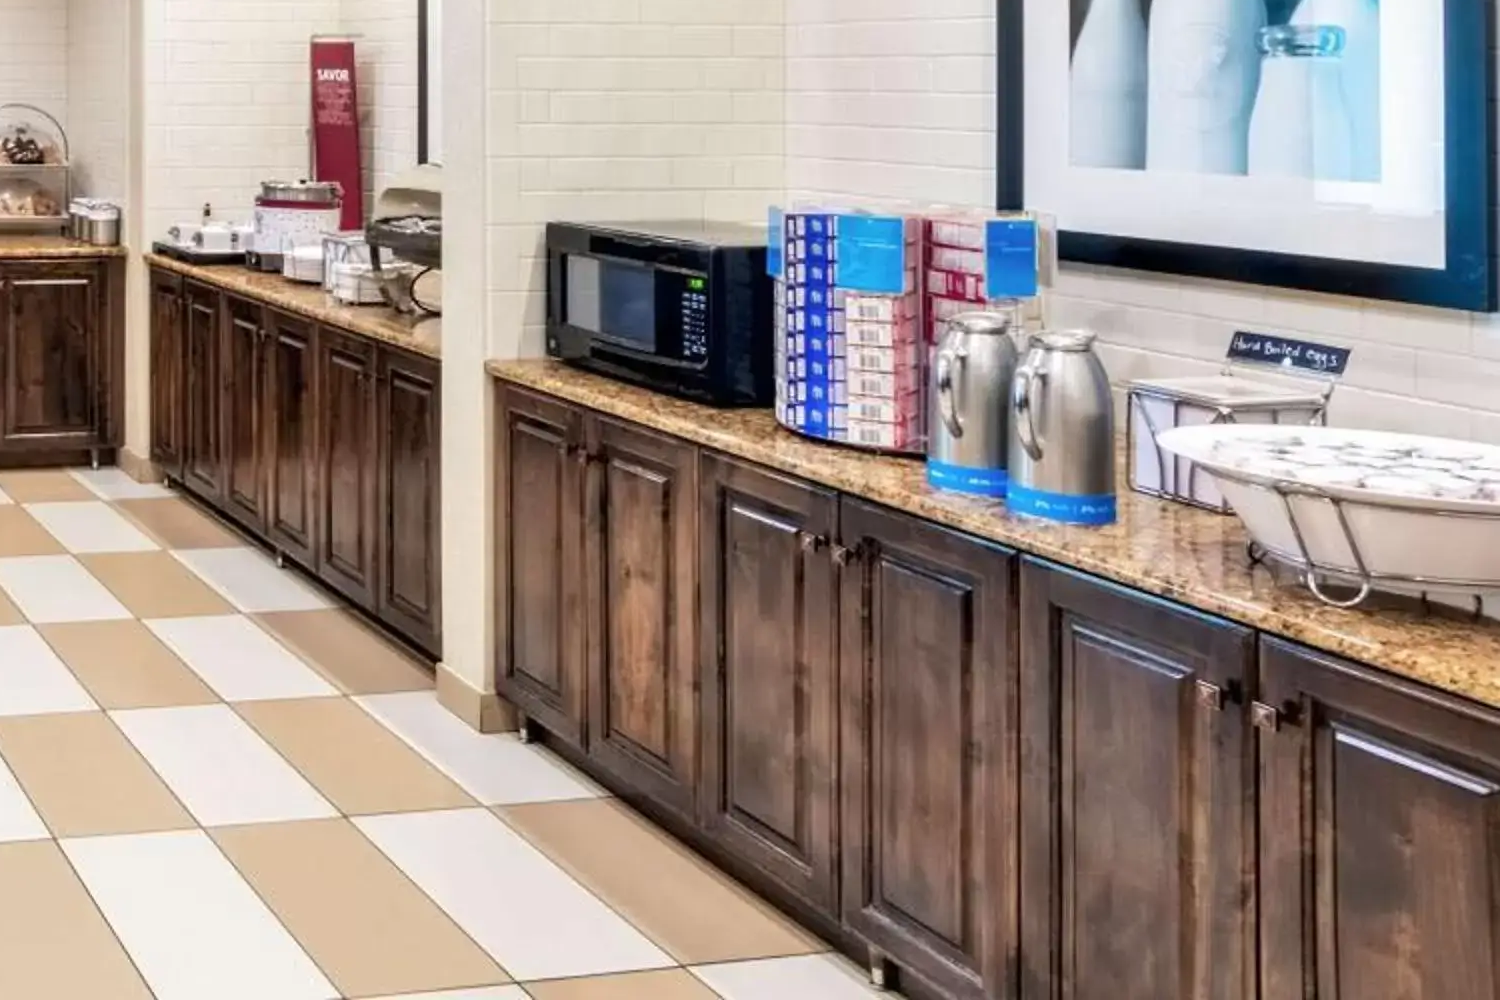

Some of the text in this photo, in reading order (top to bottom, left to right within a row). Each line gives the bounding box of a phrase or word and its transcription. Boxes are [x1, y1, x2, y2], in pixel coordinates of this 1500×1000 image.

[317, 69, 349, 81] SAVOR
[1233, 335, 1338, 369] Hard Boiled eggs
